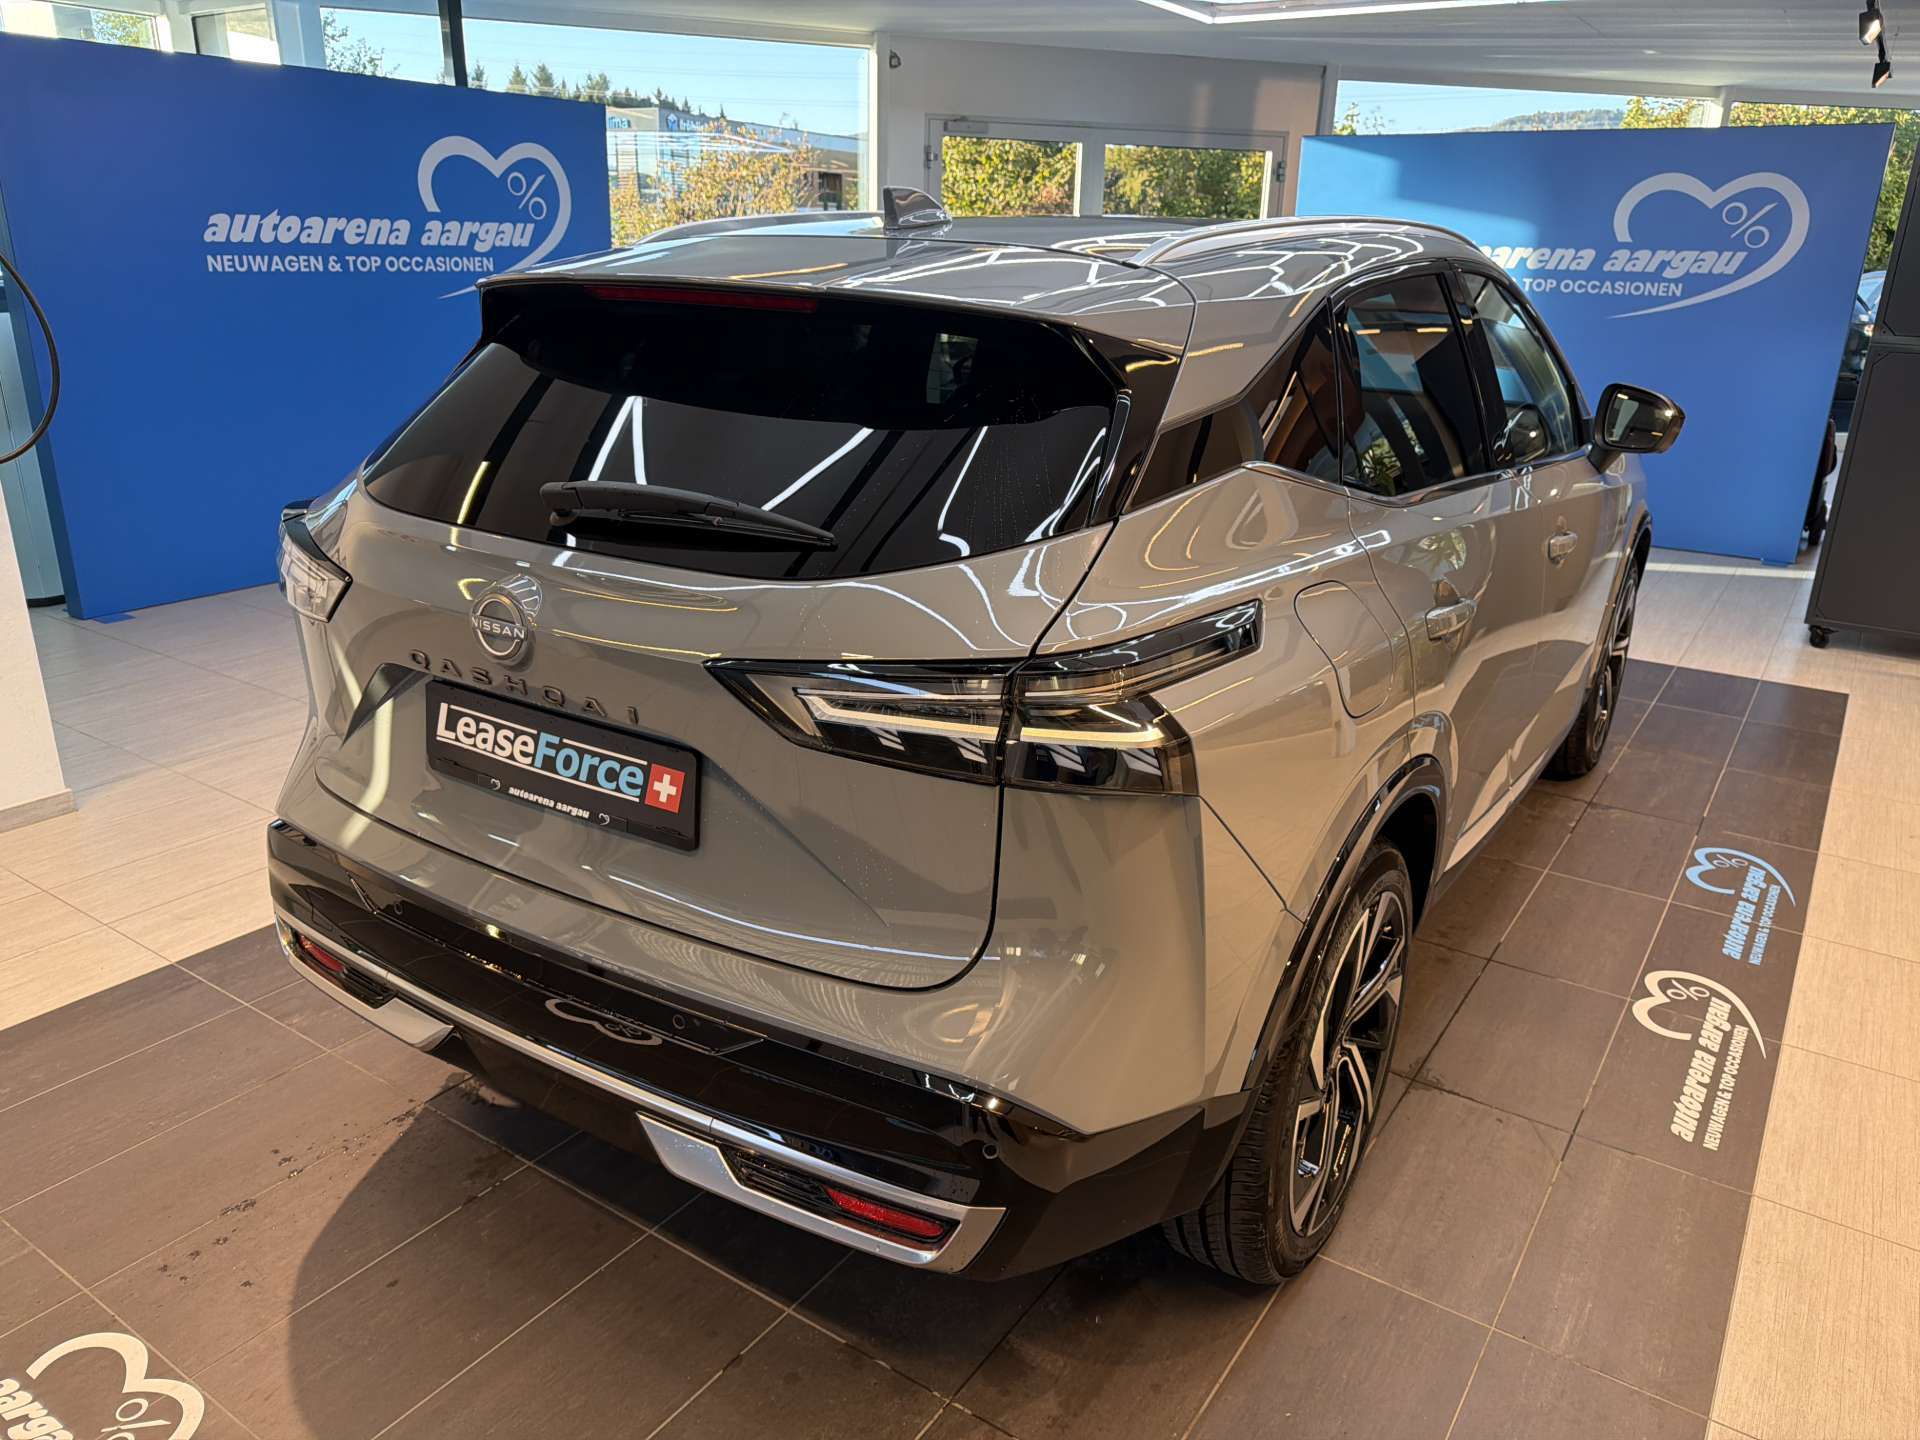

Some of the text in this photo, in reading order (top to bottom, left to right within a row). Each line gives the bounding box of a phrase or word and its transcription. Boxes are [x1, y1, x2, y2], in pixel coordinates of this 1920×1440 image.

[203, 208, 535, 253] autoarena aargau
[206, 254, 494, 273] NEUWAGEN & TOP OCCASIONEN
[1602, 248, 1749, 279] aargau
[1522, 278, 1683, 297] TOP OCCASIONEN
[471, 615, 525, 639] NISSAN
[409, 648, 640, 725] QASHQAI
[436, 702, 645, 797] LeaseForce
[508, 786, 590, 819] autoarena aargau
[1670, 996, 1732, 1143] autoarena aargau
[1702, 1024, 1750, 1151] NEUWAGEN & TOP OCCASIONEN
